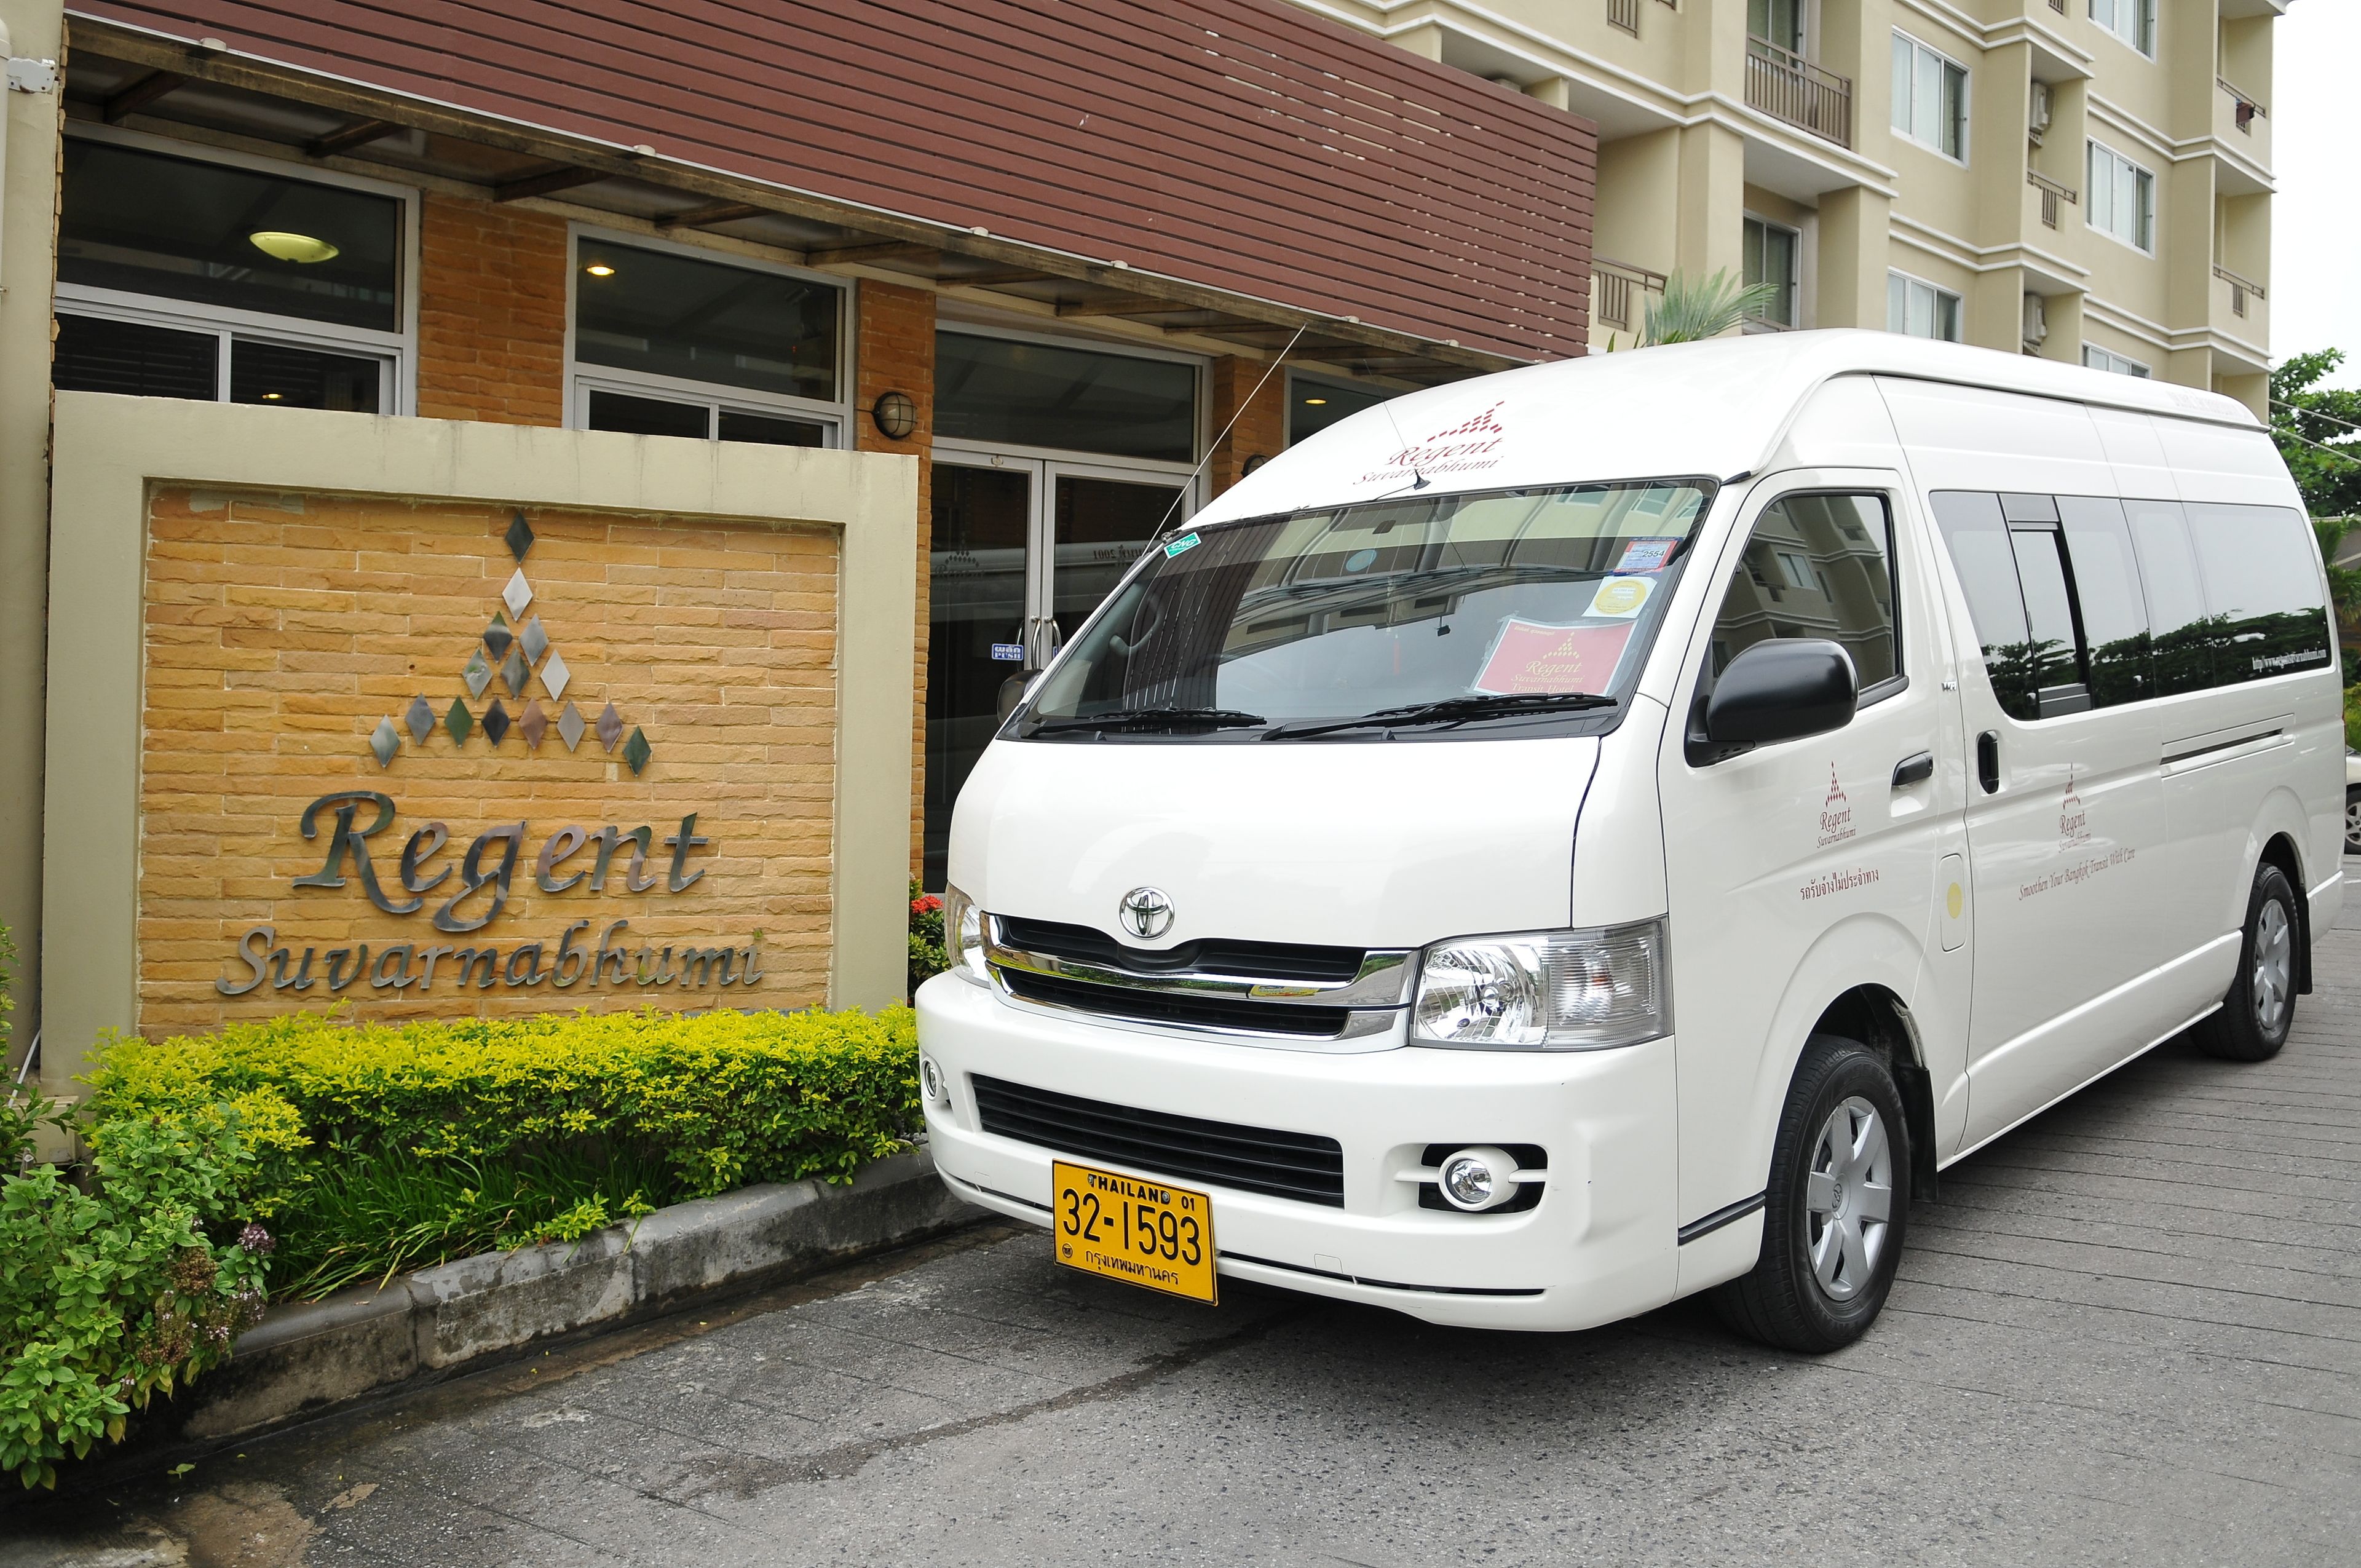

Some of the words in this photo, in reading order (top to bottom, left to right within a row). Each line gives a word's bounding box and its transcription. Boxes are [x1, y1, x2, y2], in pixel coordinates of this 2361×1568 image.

[1384, 437, 1503, 467] Regent
[1353, 455, 1505, 485] Suvarnabhumi
[1171, 538, 1196, 549] CNG
[1511, 674, 1584, 684] Suvarnabhumi
[1525, 660, 1583, 676] Regent
[1511, 683, 1544, 693] Transit
[1548, 684, 1574, 693] Hotel
[1820, 807, 1851, 834] Regent
[2060, 810, 2086, 837] Regent
[1817, 825, 1856, 849] Suvarnabhumi
[292, 790, 710, 932] Regent
[2019, 876, 2048, 900] Smoothen
[2049, 872, 2064, 888] Your
[2065, 860, 2090, 884] Bangkok
[2110, 847, 2123, 866] With
[1800, 868, 1880, 900] รถรับจ้างไม่ประจำทาง
[215, 919, 765, 996] Suvarnabhumi
[1088, 1173, 1171, 1205] THAILAND
[1180, 1195, 1195, 1211] 01
[1062, 1187, 1201, 1266] 32-1593
[1085, 1249, 1179, 1285] กรุงเทพมหานคร
